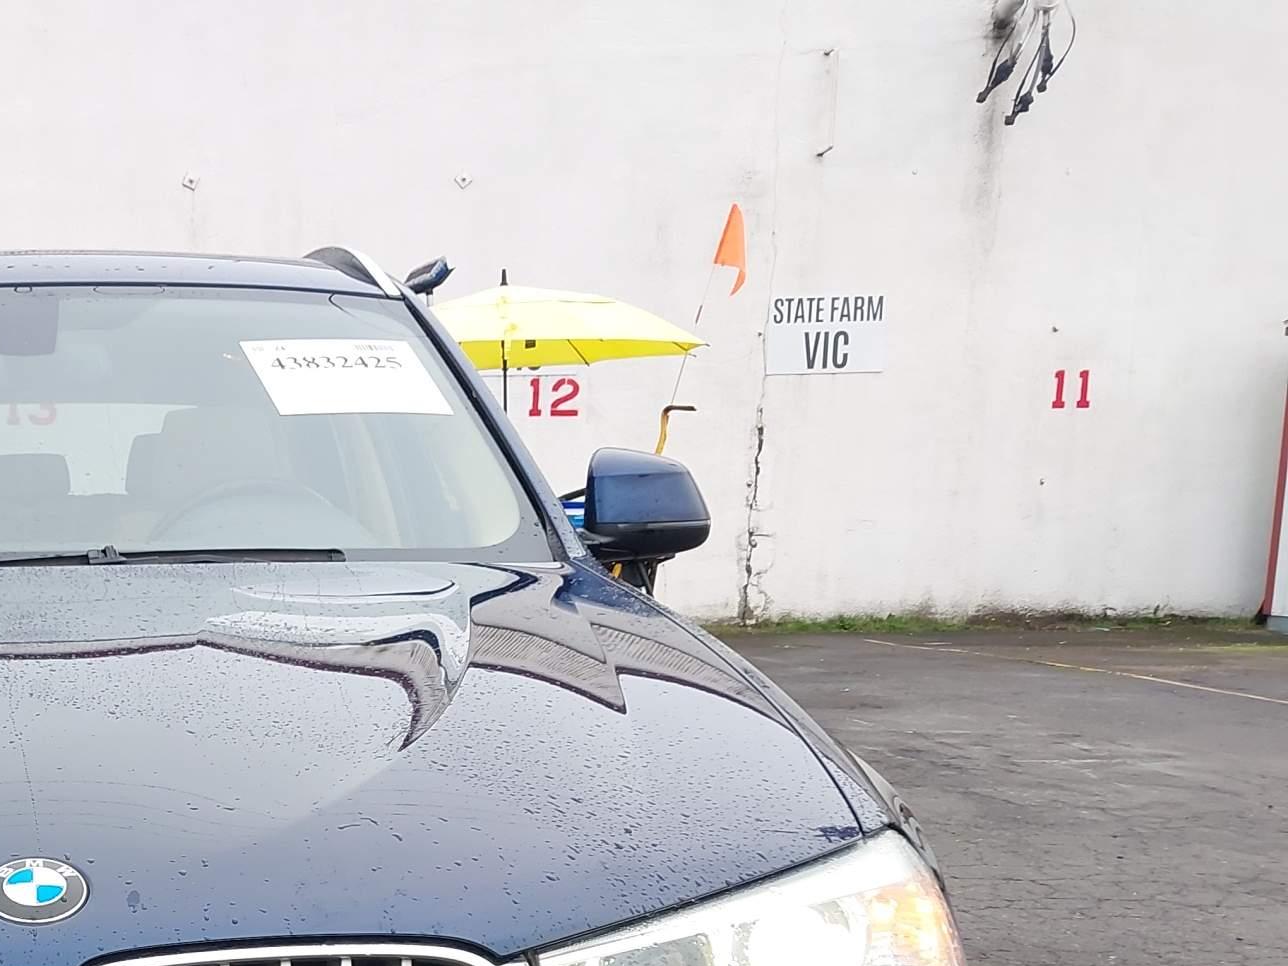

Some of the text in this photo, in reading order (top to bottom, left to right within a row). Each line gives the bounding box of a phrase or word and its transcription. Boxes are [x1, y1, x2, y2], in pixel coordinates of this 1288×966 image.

[774, 296, 884, 324] STATE FARM
[271, 356, 402, 369] 43832425
[804, 331, 849, 369] VIC
[529, 378, 580, 417] 12
[1052, 369, 1090, 409] 11
